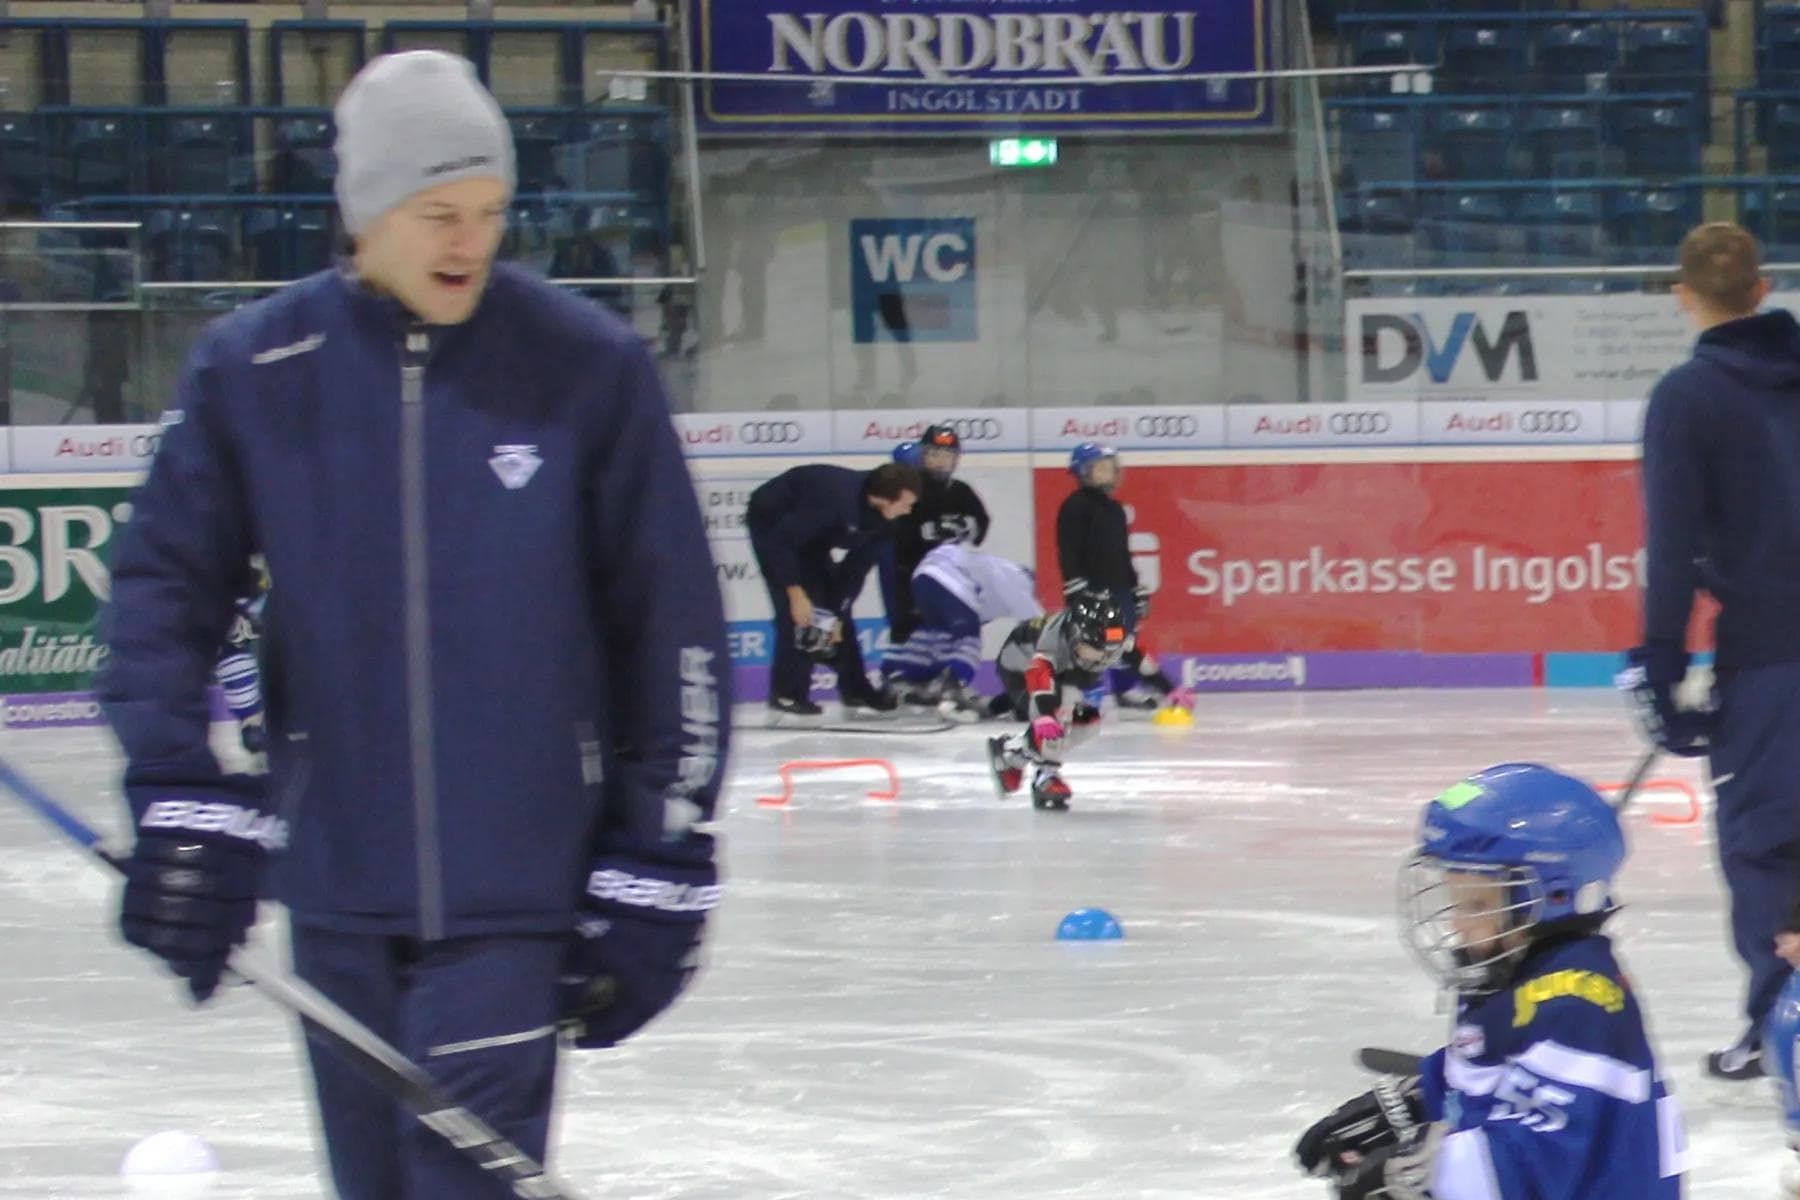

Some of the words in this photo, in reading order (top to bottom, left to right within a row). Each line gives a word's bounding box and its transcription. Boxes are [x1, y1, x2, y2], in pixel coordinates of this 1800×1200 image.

[766, 11, 1196, 82] NORDBRÄU
[888, 88, 1082, 111] INGOLSTADT
[860, 232, 967, 283] WC
[1060, 417, 1128, 438] Audi
[1253, 415, 1320, 435] Audi
[1446, 412, 1512, 432] Audi
[55, 437, 123, 457] Audi
[1188, 546, 1457, 606] Sparkasse
[1196, 662, 1286, 681] covestro
